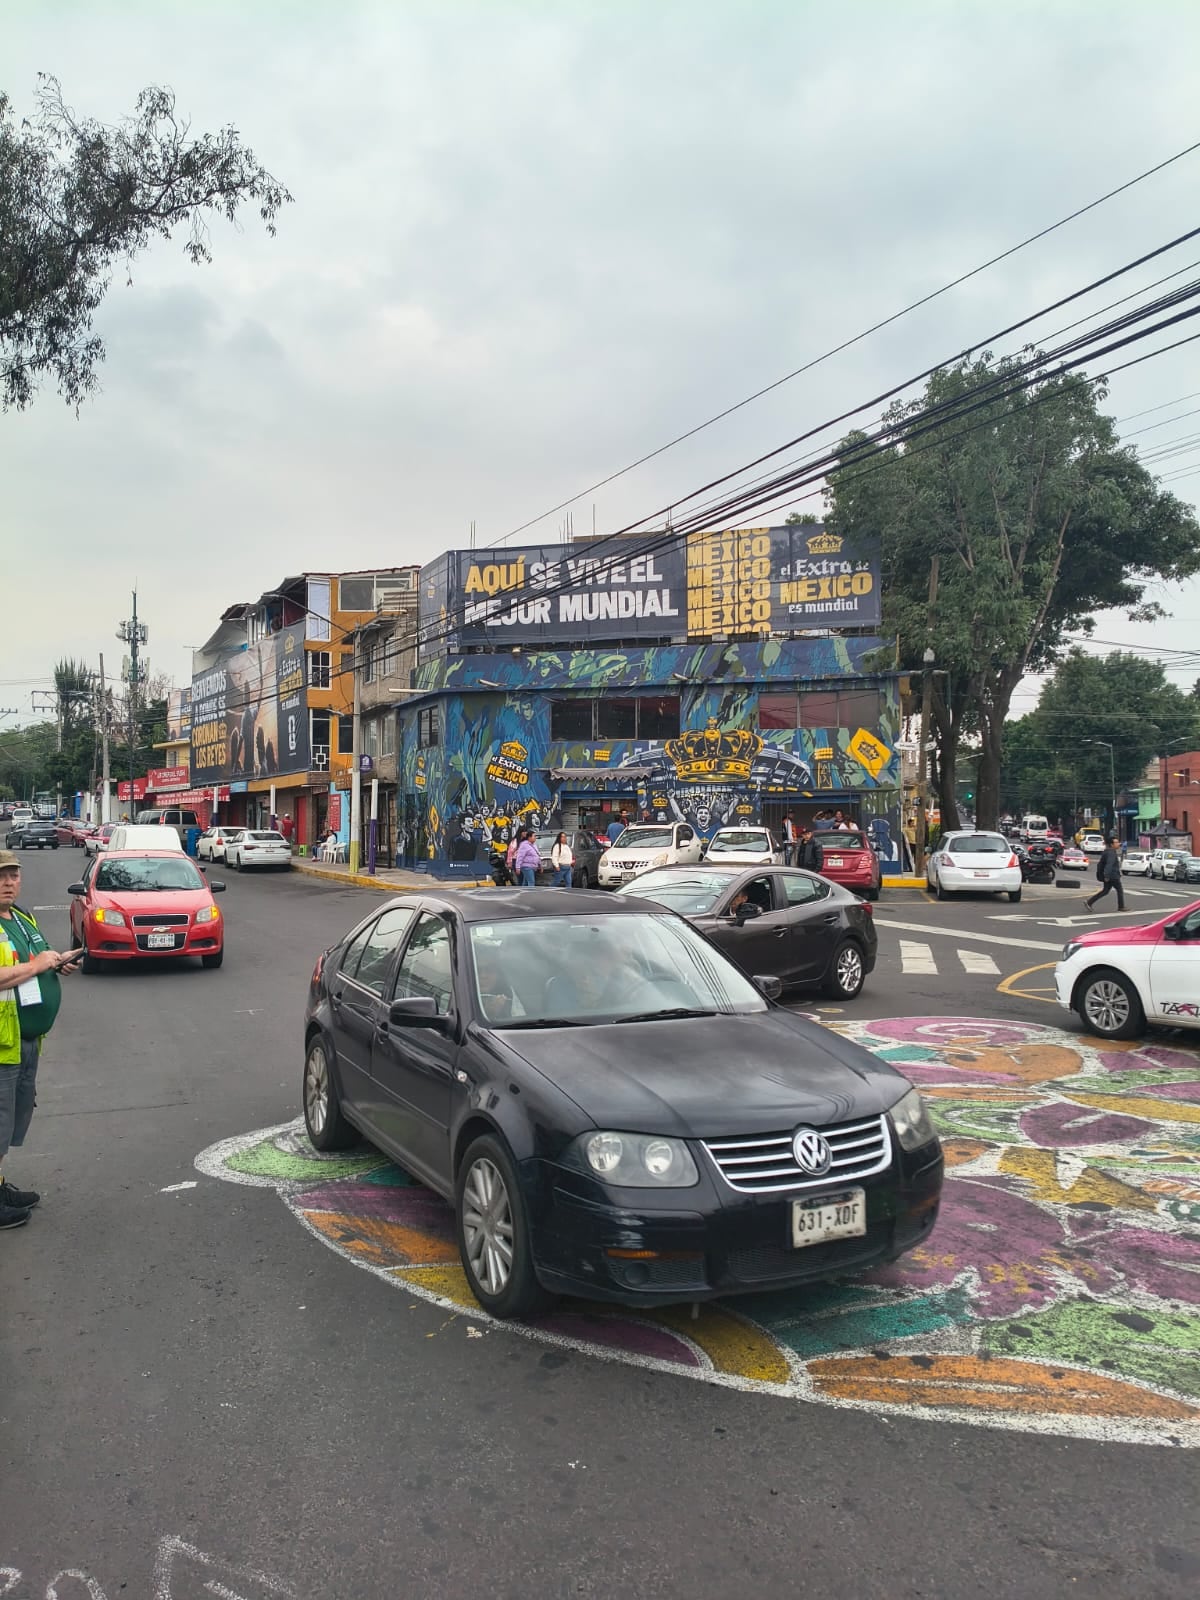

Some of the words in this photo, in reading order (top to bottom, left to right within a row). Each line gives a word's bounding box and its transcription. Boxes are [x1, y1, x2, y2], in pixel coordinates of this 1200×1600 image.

[687, 536, 770, 568] MEXICO
[780, 564, 791, 576] el
[795, 558, 853, 577] Extra
[464, 554, 527, 597] AQUÍ
[529, 561, 562, 590] SE
[566, 554, 627, 587] VIVE
[630, 554, 663, 583] EL
[687, 557, 771, 589] MEXICO
[780, 572, 873, 605] MÉXICO
[464, 596, 552, 626] MEJOR
[559, 588, 679, 623] MUNDIAL
[687, 579, 771, 610] MEXICO
[788, 603, 803, 614] es
[804, 597, 859, 614] mundial
[687, 600, 771, 631] MEXICO
[487, 764, 529, 785] MÉXICO
[498, 756, 522, 772] Extra
